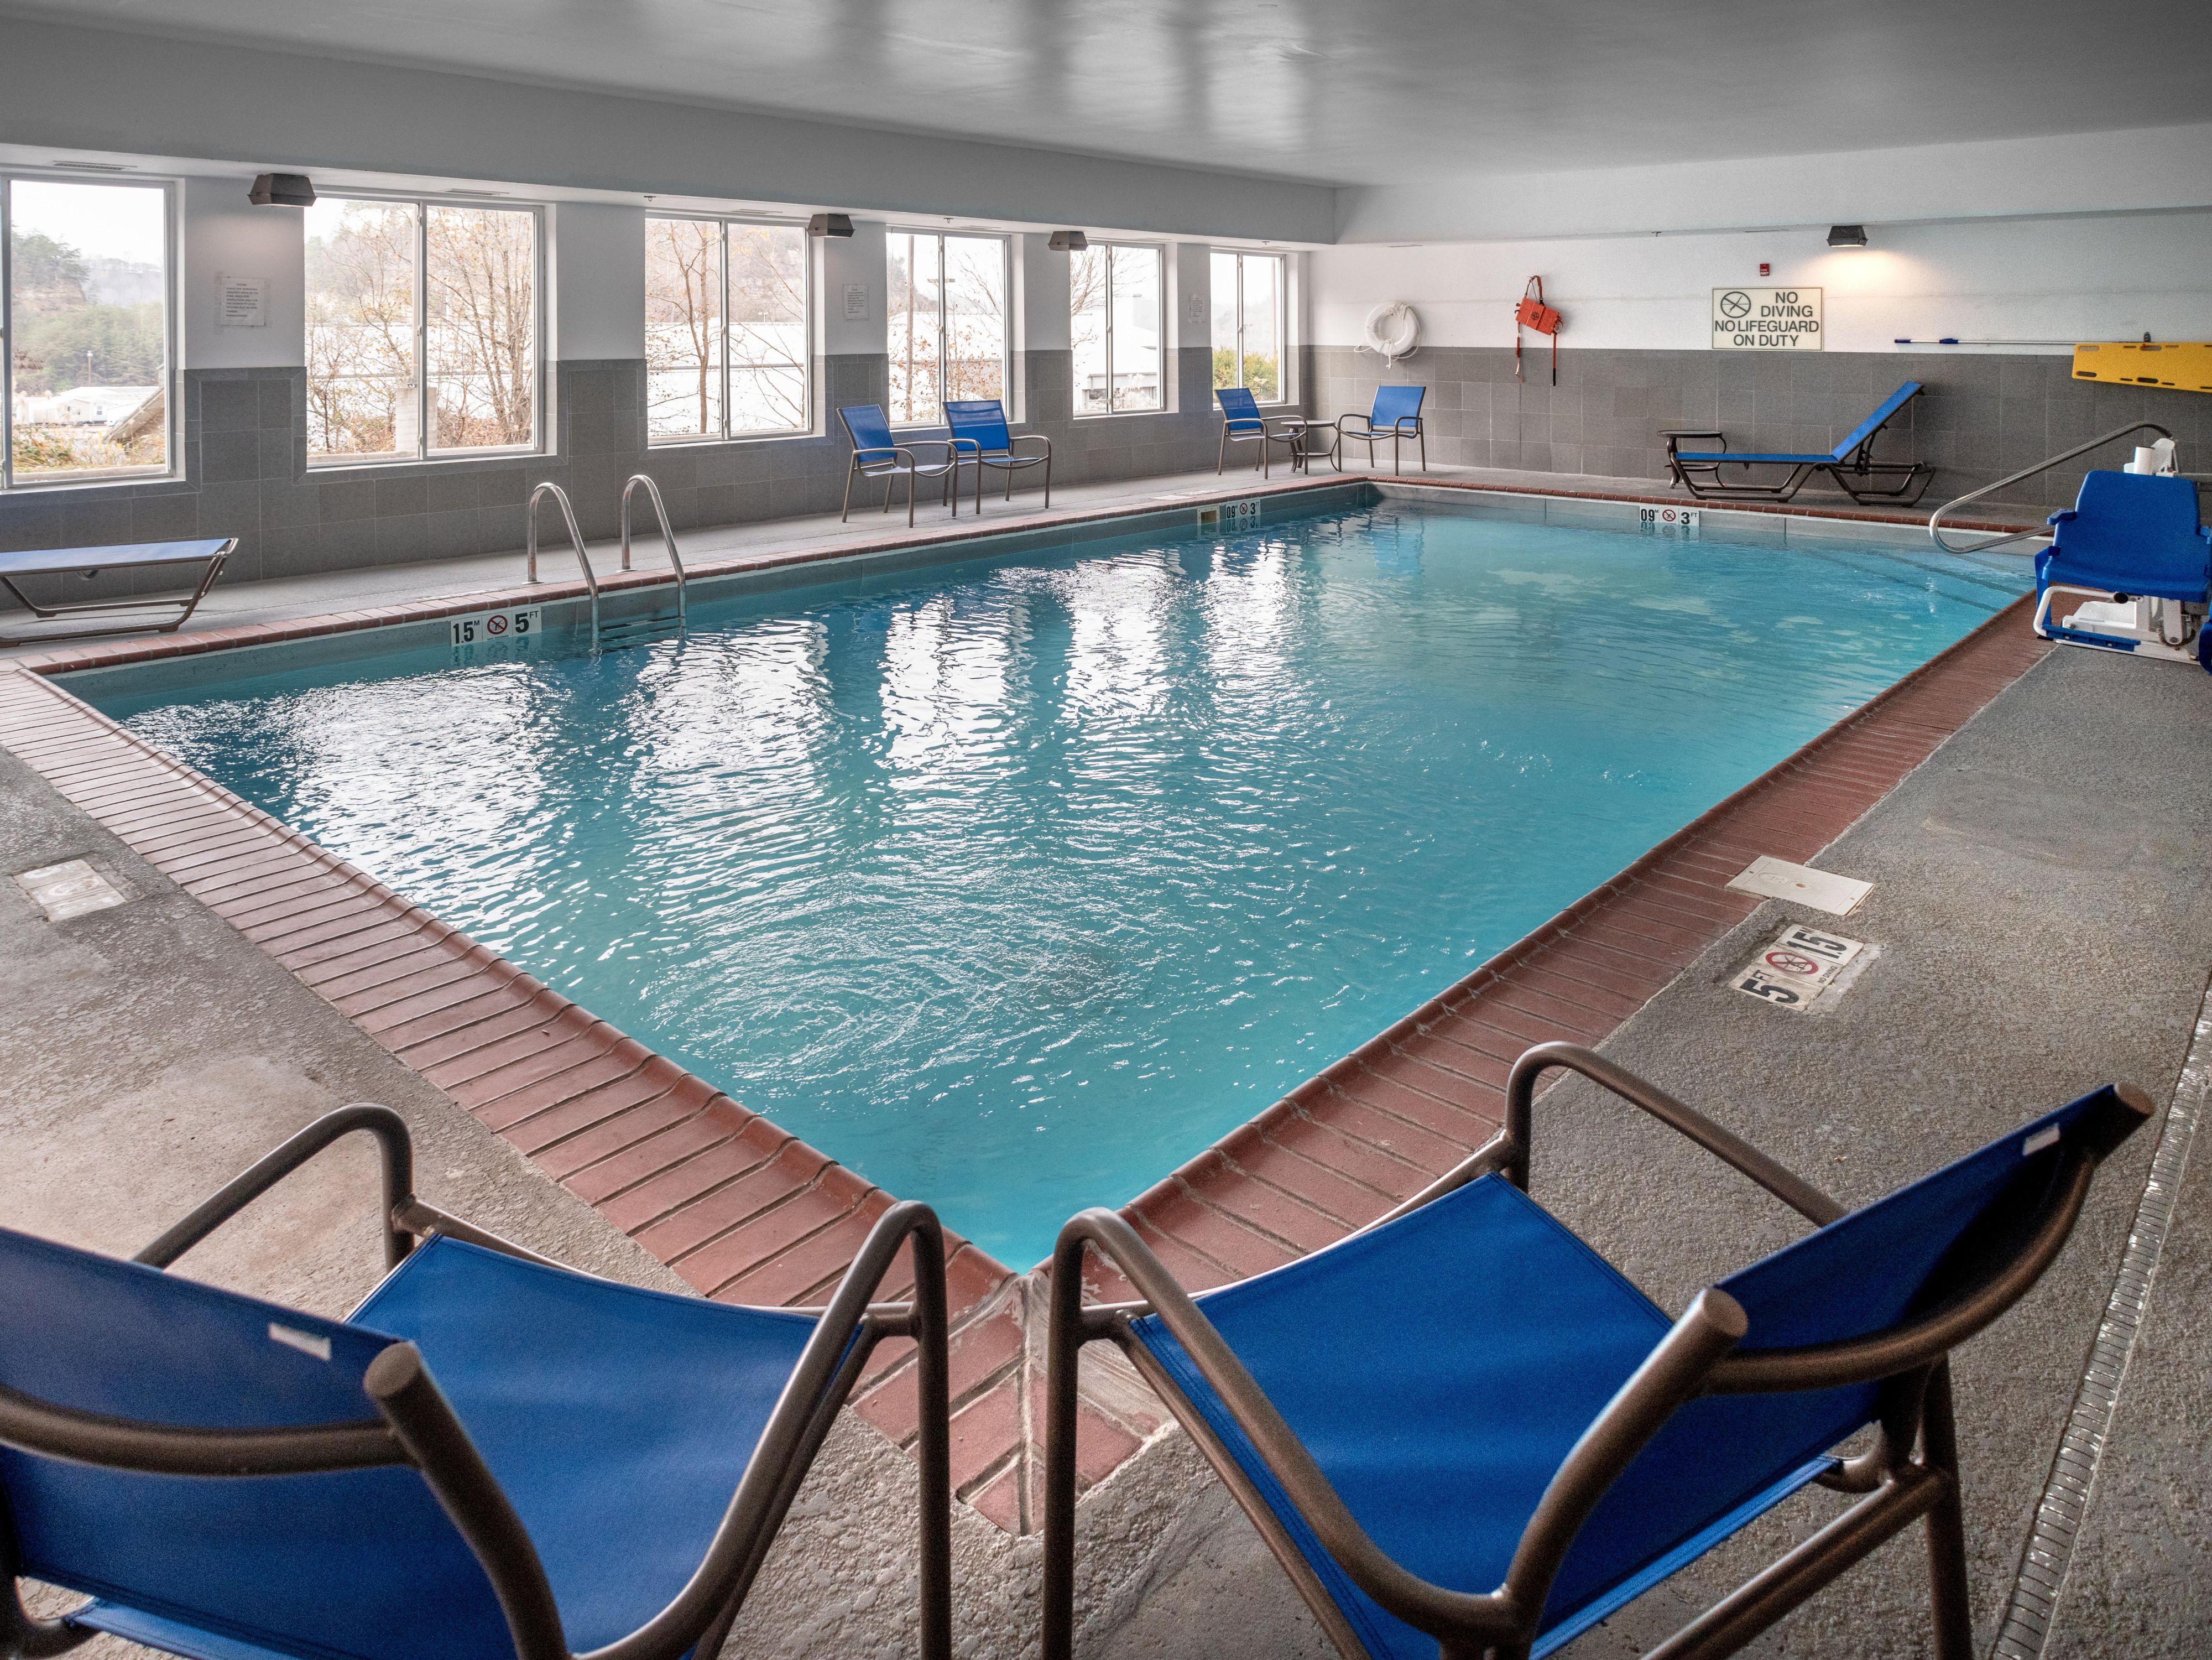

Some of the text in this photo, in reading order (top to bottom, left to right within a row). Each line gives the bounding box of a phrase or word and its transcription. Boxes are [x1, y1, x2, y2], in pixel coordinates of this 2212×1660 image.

[1775, 292, 1798, 304] NO
[1761, 305, 1813, 317] DIVING
[1715, 320, 1819, 332] NO LIFEGUARD
[1734, 334, 1799, 346] ON DUTY
[1250, 502, 1256, 515] 3
[1681, 512, 1690, 525] 3
[515, 610, 539, 633] 5 FT
[453, 621, 474, 644] 1.5
[1823, 965, 1838, 979] DIVING
[1739, 969, 1799, 1004] 5 FT
